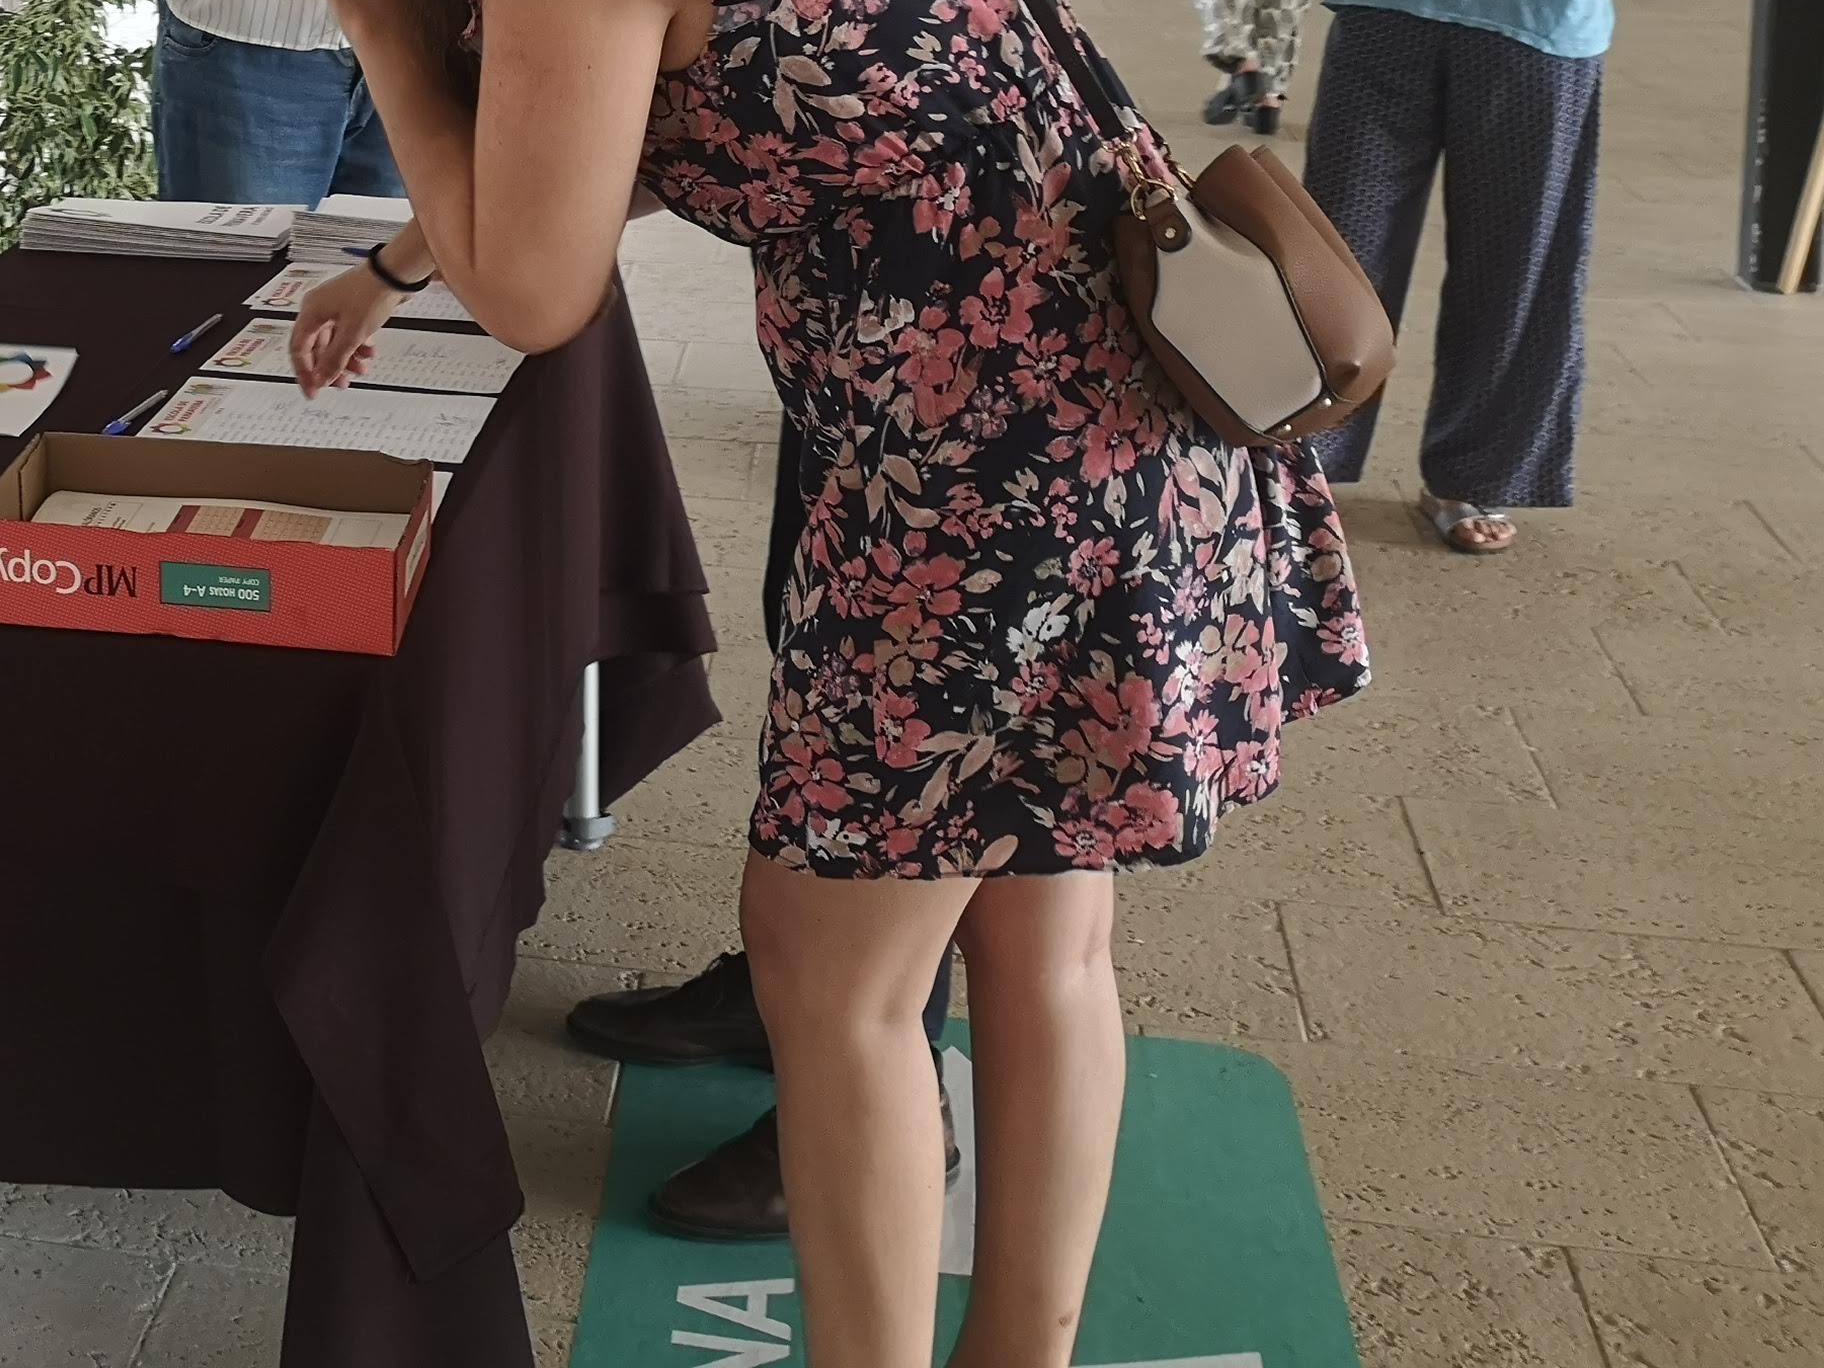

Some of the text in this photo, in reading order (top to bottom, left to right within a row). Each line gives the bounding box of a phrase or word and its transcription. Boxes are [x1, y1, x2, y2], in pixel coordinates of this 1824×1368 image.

[241, 577, 260, 586] COPY
[183, 584, 260, 601] 500 HOJAS A-4
